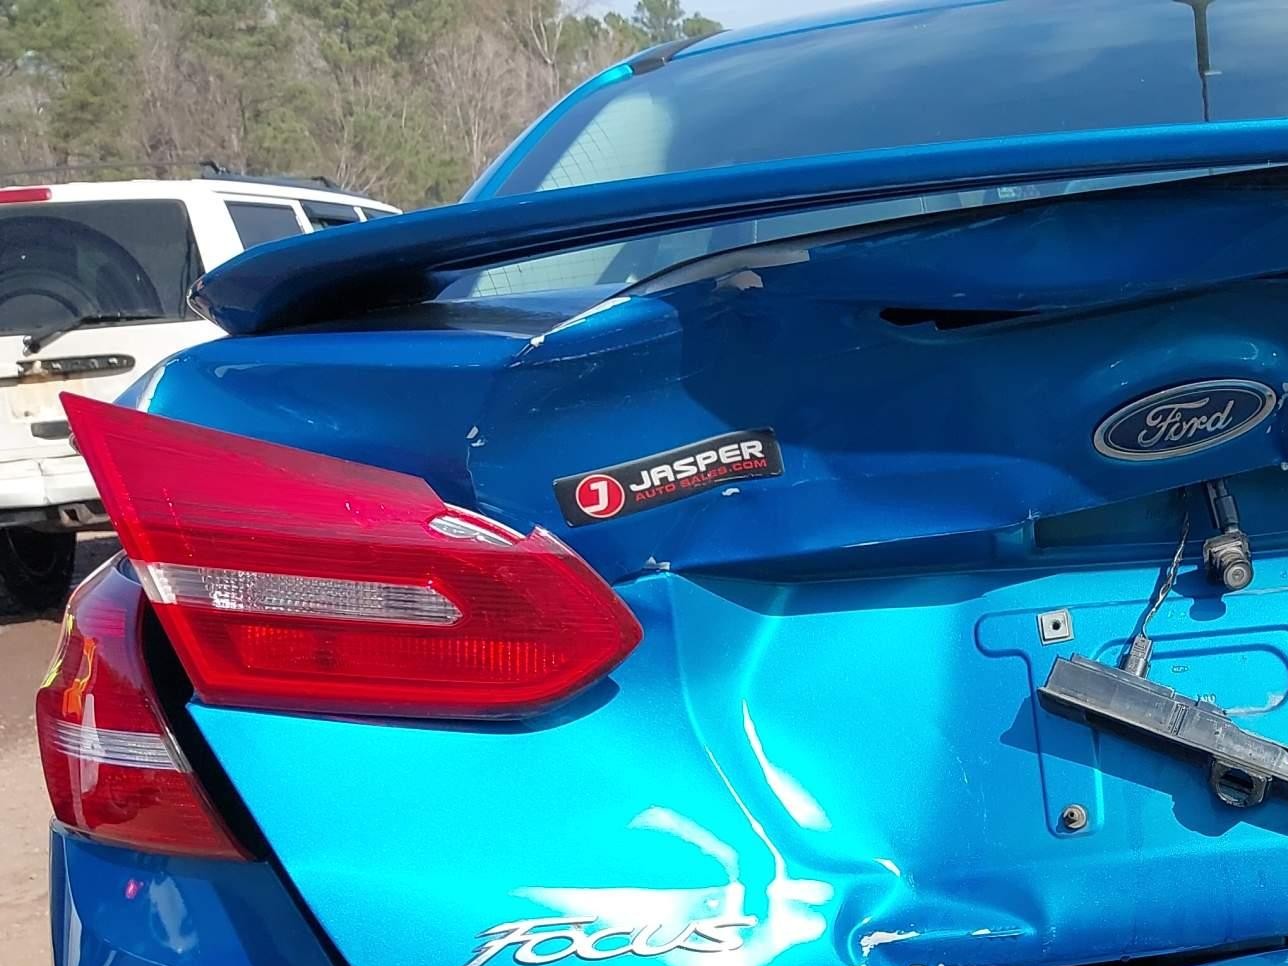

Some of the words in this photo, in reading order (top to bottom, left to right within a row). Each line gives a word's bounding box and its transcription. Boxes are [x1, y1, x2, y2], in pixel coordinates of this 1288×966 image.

[1137, 397, 1235, 448] Ford
[629, 440, 765, 492] JASPER
[634, 483, 676, 502] AUTO
[681, 458, 768, 489] SALES.COM
[583, 480, 608, 513] J
